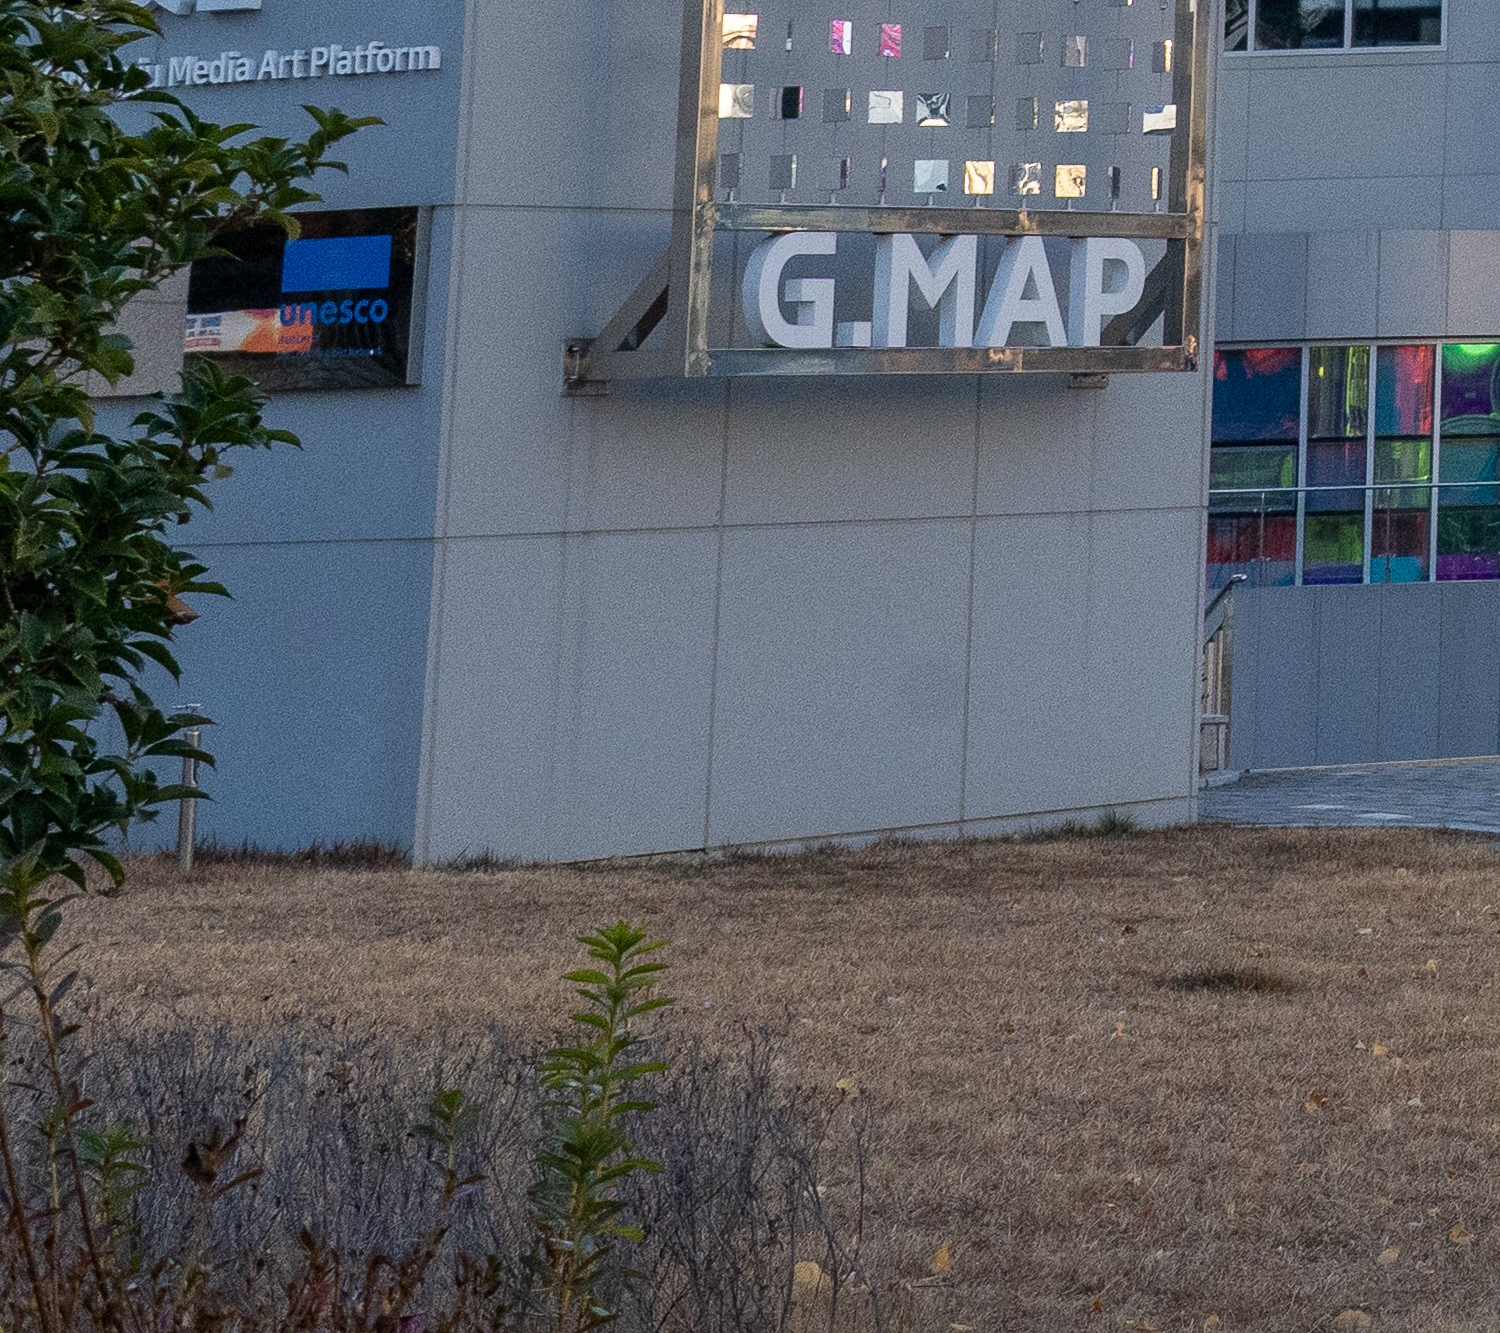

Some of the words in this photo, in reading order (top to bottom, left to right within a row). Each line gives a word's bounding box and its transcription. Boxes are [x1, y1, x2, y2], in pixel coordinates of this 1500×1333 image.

[168, 51, 250, 85] Media
[257, 49, 310, 81] Art
[310, 41, 441, 77] Platform
[279, 298, 389, 326] unesco
[745, 232, 1147, 348] G.MAP
